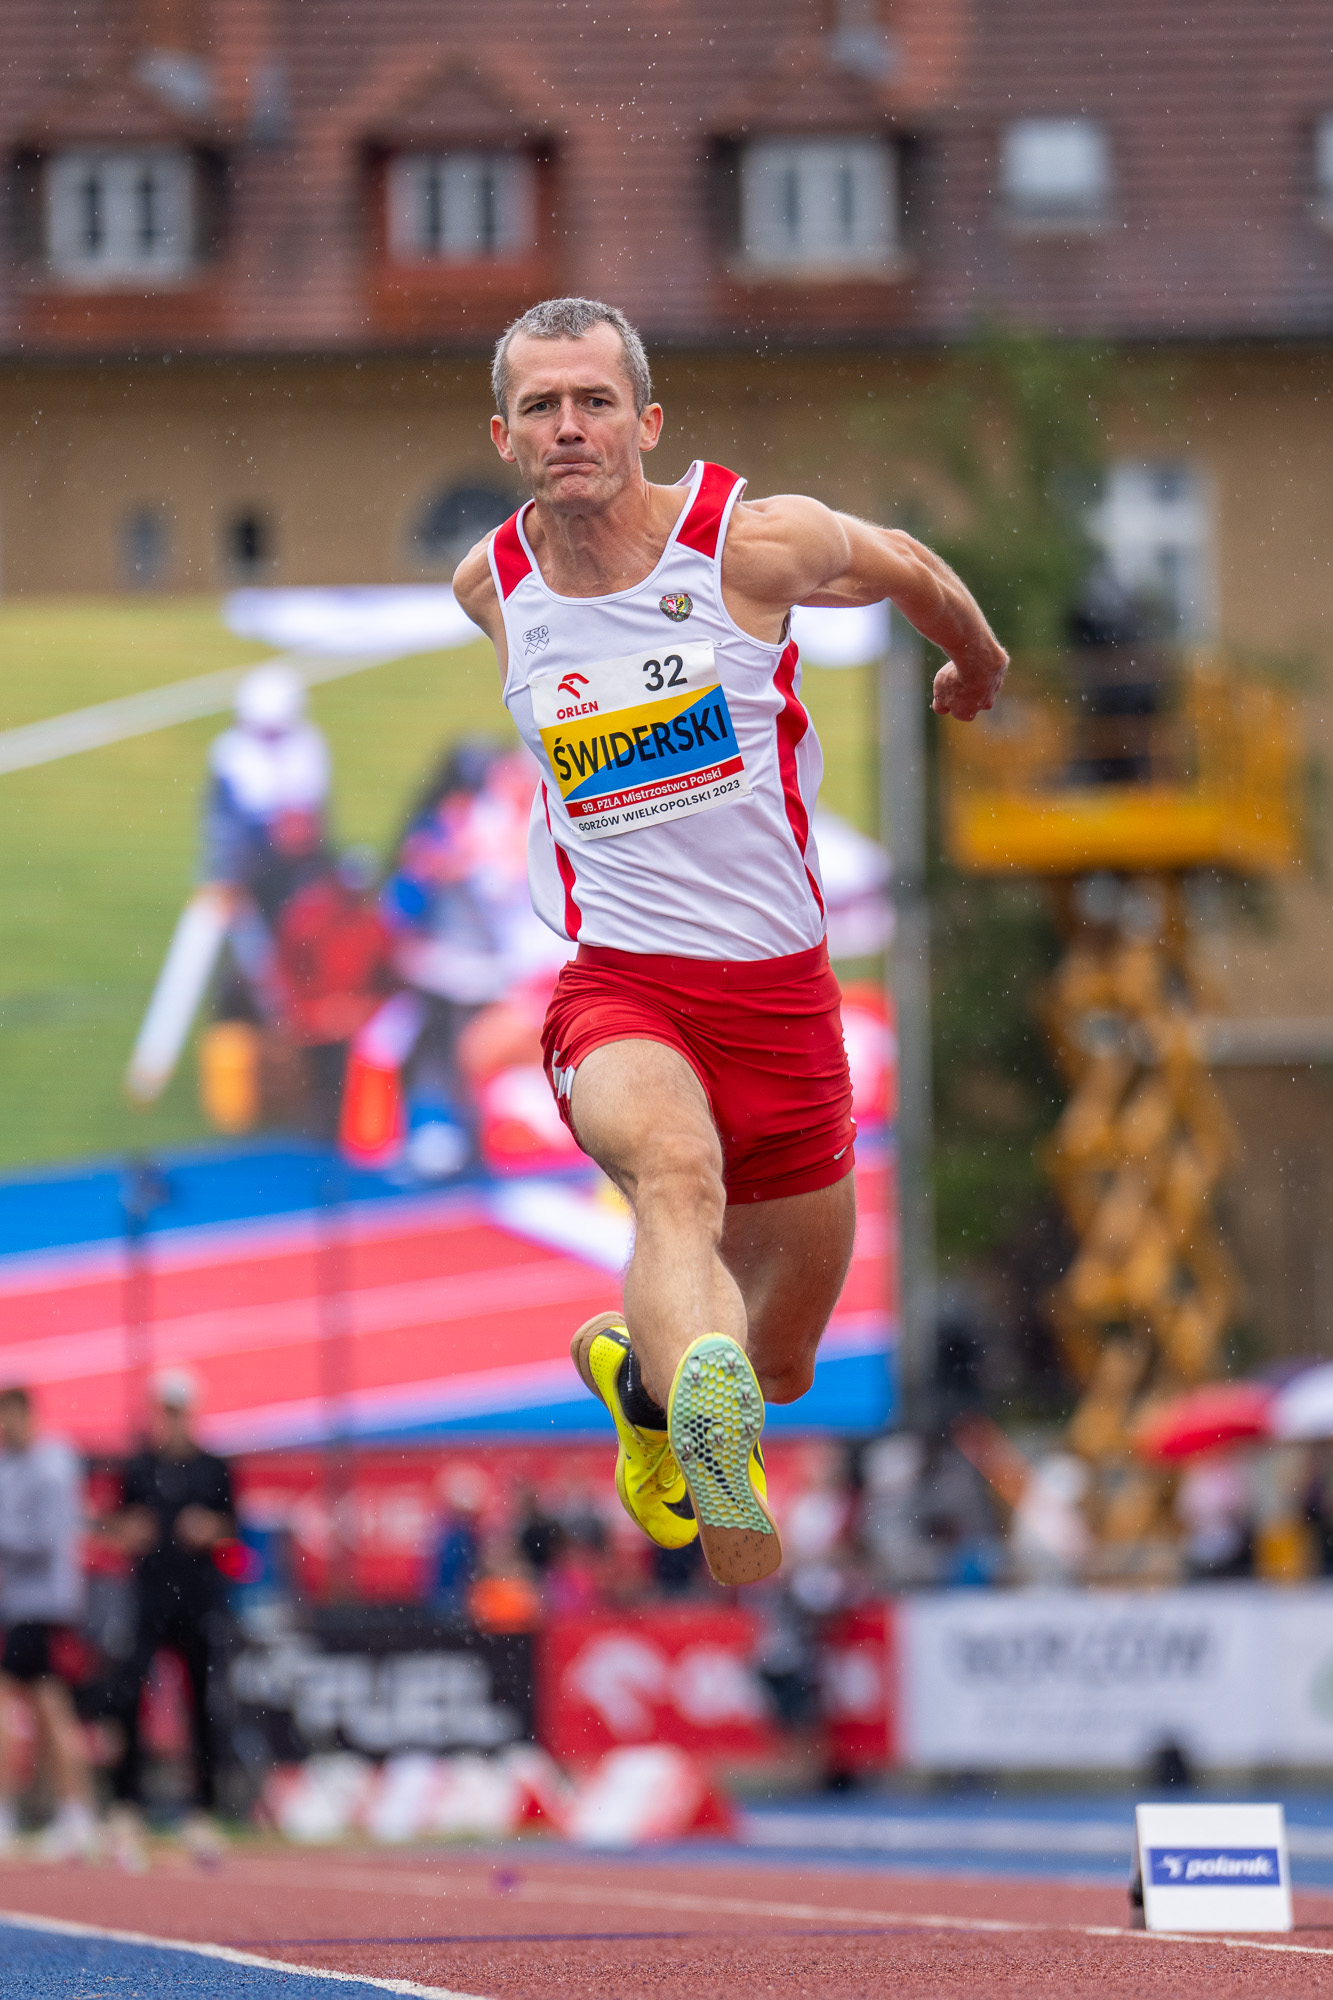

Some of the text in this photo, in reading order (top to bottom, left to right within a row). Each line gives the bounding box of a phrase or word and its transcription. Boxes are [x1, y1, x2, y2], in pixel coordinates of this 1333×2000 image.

[643, 654, 688, 691] 32
[557, 700, 599, 720] ORLEN
[553, 704, 728, 781] ŚWIDERSKI
[578, 779, 741, 832] GORZÓW WIELKOPOLSKI 2023
[581, 767, 722, 813] 99. PZLA Mistrzostwa Polski
[1185, 1854, 1274, 1880] polanik
